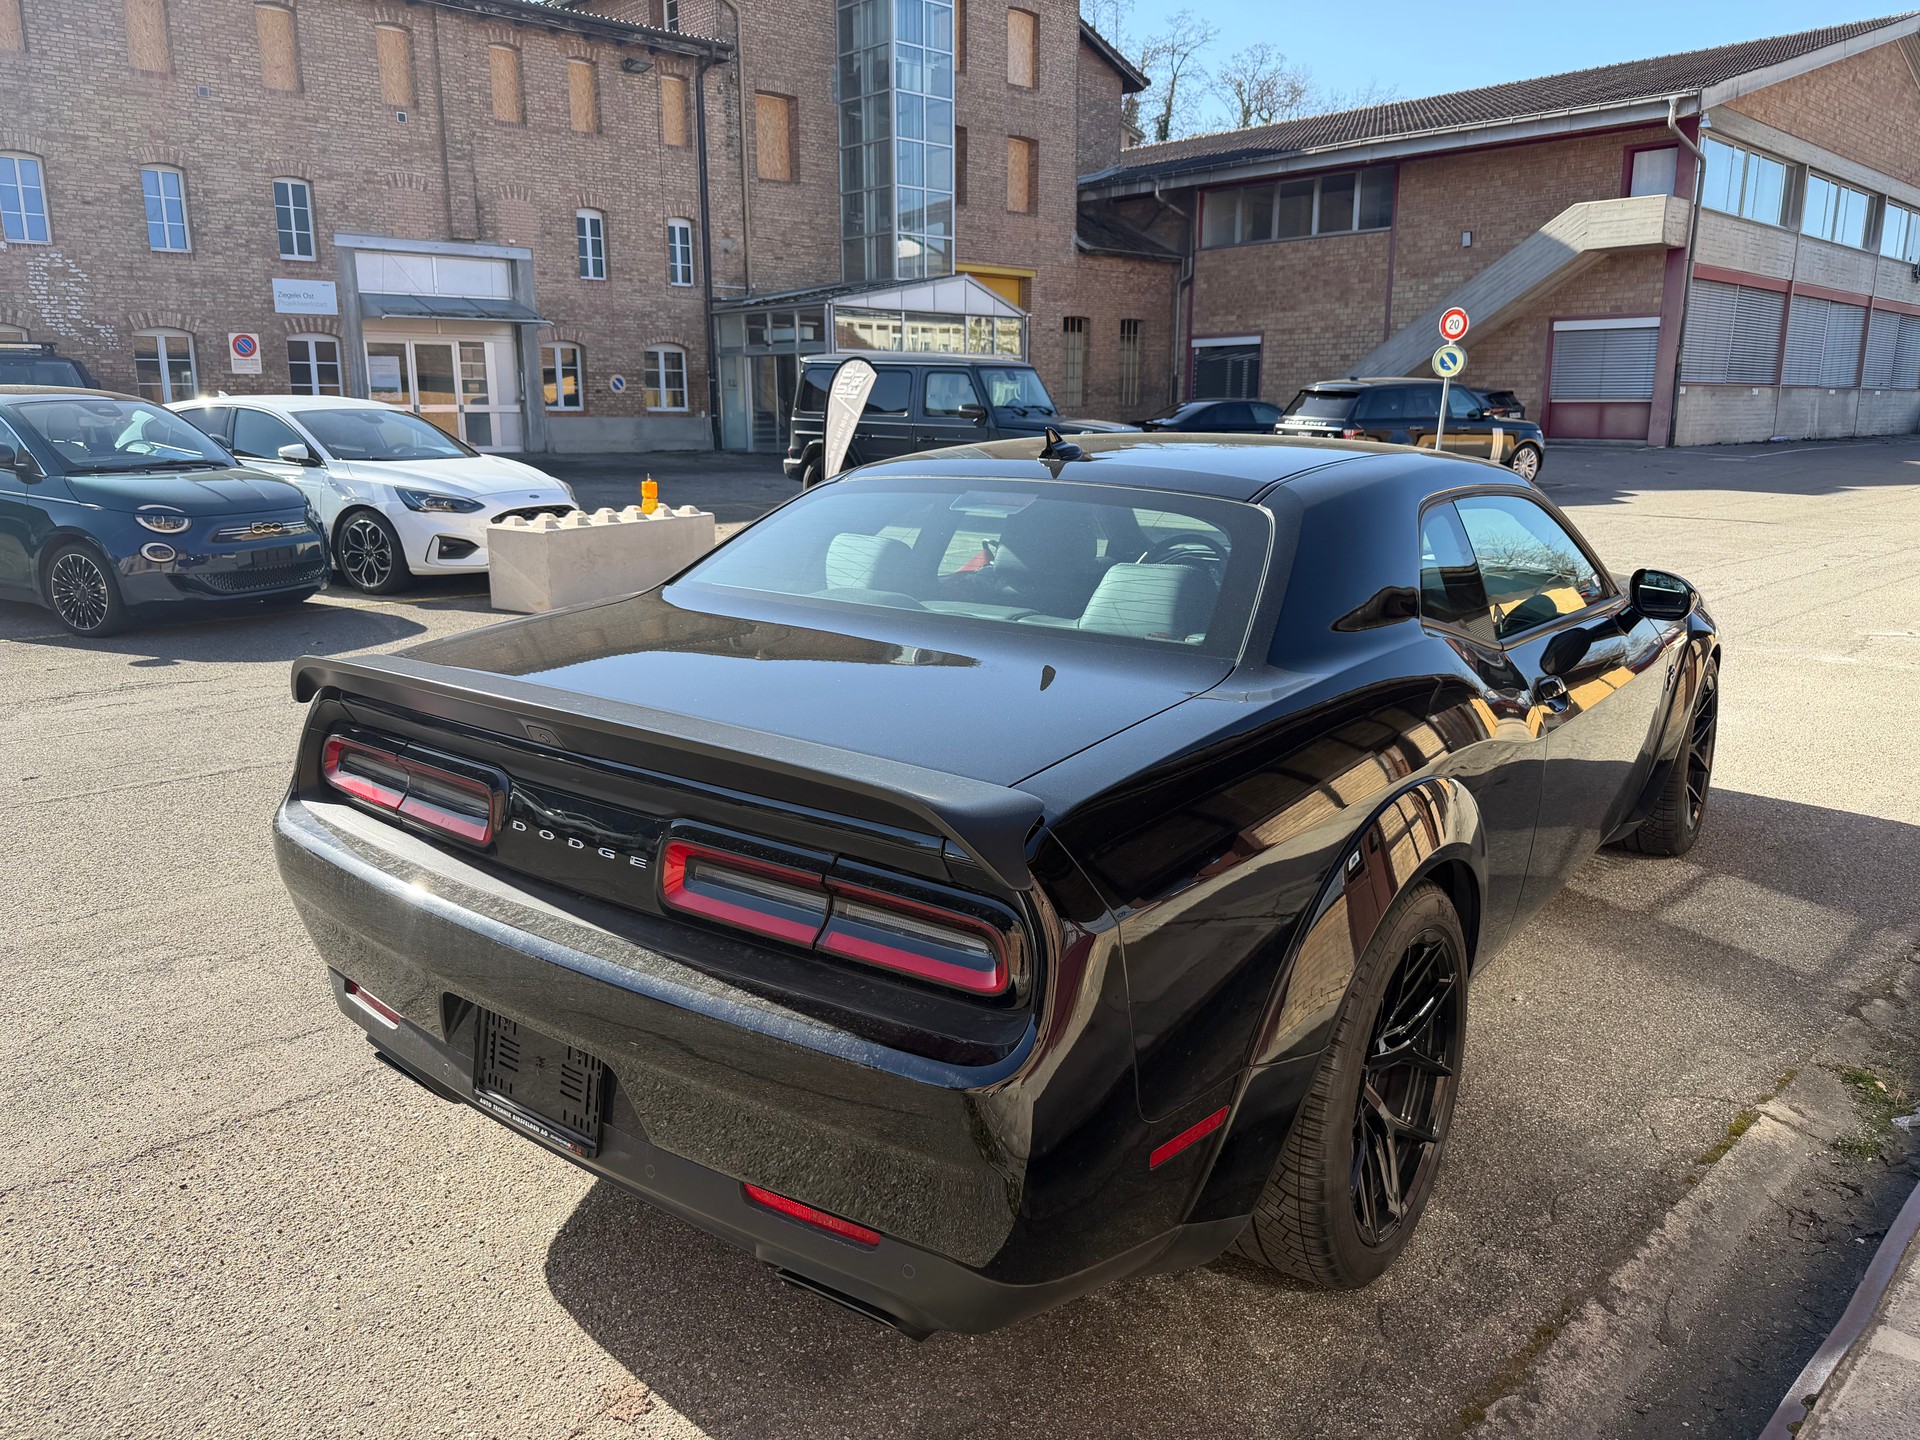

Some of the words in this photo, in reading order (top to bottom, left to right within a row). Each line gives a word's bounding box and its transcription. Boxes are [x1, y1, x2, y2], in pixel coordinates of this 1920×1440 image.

[277, 291, 302, 299] Ziegelei
[302, 292, 315, 300] Ost
[1449, 319, 1460, 330] 20
[251, 521, 282, 534] 500
[512, 820, 647, 869] DODGE
[479, 1097, 492, 1108] AUTO
[492, 1103, 512, 1120] TECHNIK
